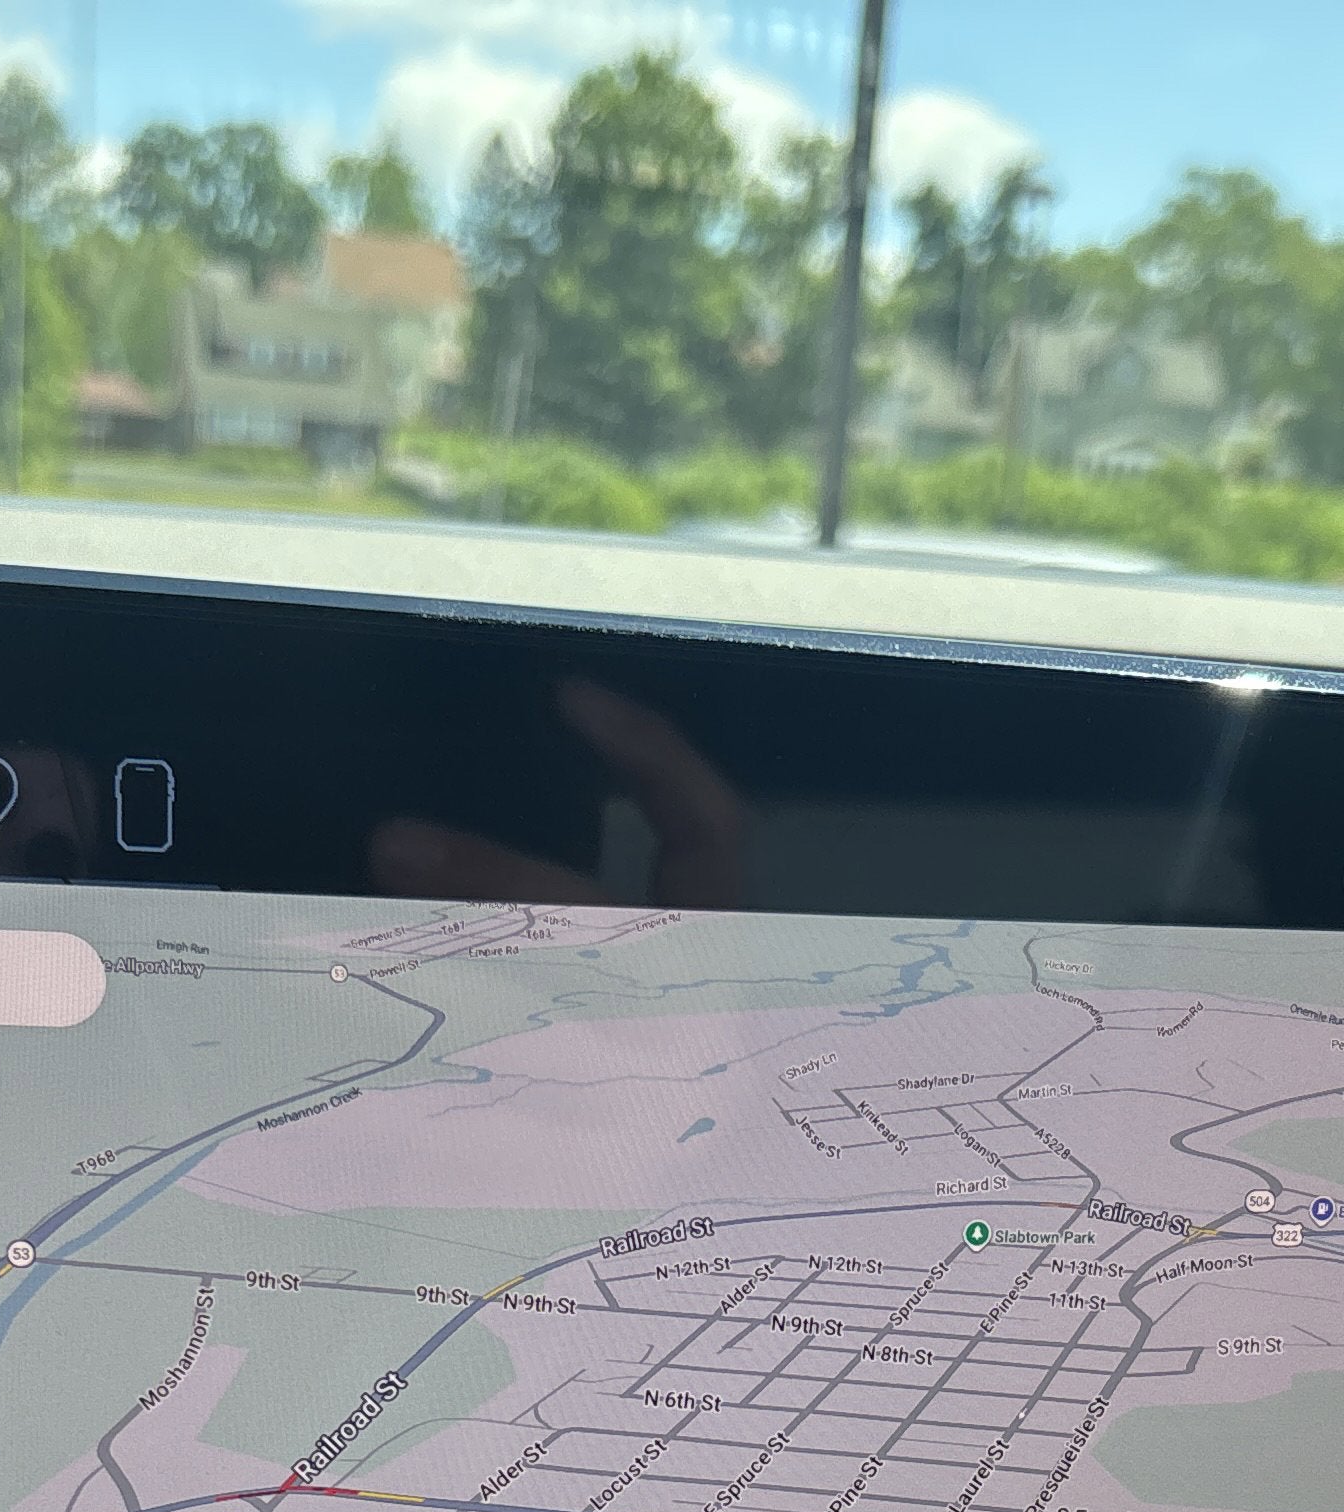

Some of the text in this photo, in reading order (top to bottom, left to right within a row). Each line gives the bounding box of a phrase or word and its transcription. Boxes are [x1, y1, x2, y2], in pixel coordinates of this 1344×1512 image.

[115, 957, 168, 977] Allport
[170, 959, 204, 979] Hwy
[1036, 983, 1059, 999] Loch
[786, 1053, 836, 1080] Shady Ln
[961, 1073, 975, 1084] Dr
[1018, 1086, 1071, 1100] Martin St
[796, 1116, 842, 1159] Jesse St
[77, 1150, 117, 1176] T968
[937, 1176, 1007, 1195] Richard St
[1249, 1195, 1271, 1209] 504
[1088, 1200, 1192, 1236] Railroad St
[995, 1230, 1095, 1246] Slabtown Park
[1275, 1229, 1299, 1243] 322
[12, 1249, 30, 1261] 53
[1052, 1260, 1124, 1278] N 13th St
[246, 1271, 300, 1292] 9th St
[417, 1287, 469, 1306] 9th St
[139, 1288, 214, 1411] Moshannon St
[1089, 1398, 1110, 1420] St
[294, 1372, 407, 1483] Railroad St
[988, 1439, 1010, 1463] St
